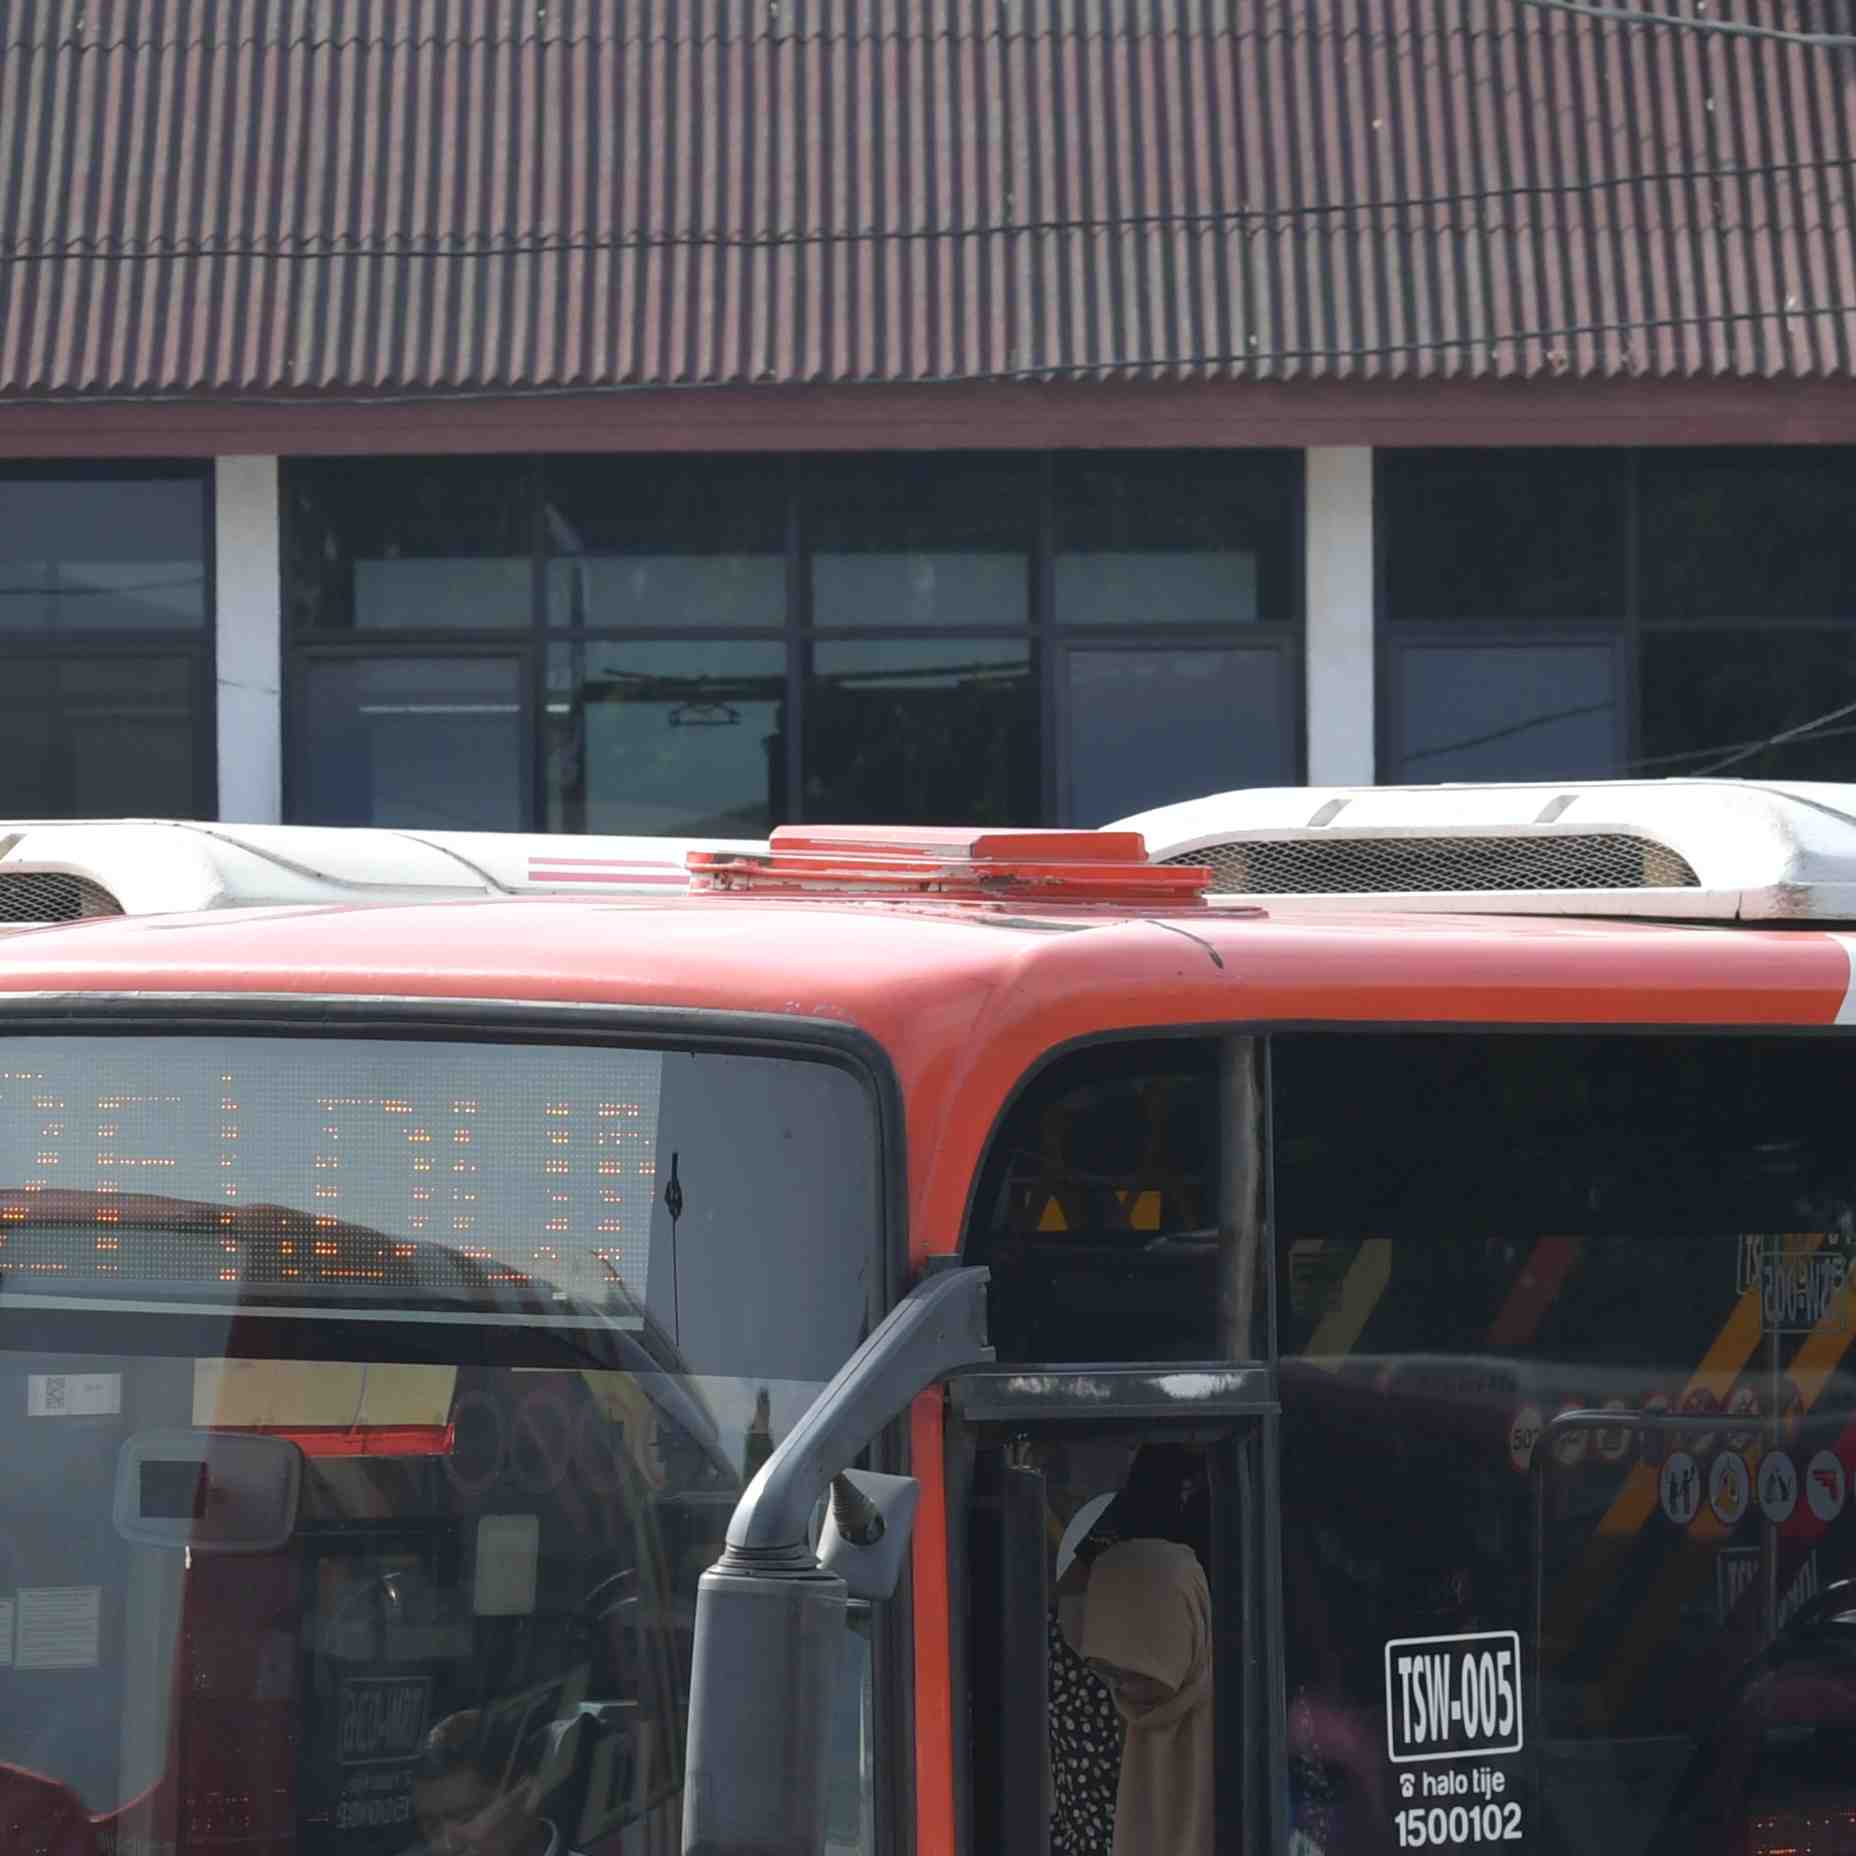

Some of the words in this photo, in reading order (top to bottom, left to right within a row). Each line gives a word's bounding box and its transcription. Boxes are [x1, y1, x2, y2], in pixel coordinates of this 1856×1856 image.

[1397, 1650, 1514, 1744] TSW-005
[1422, 1770, 1468, 1797] halo
[1472, 1767, 1506, 1801] tije
[1394, 1801, 1523, 1848] 1500102
